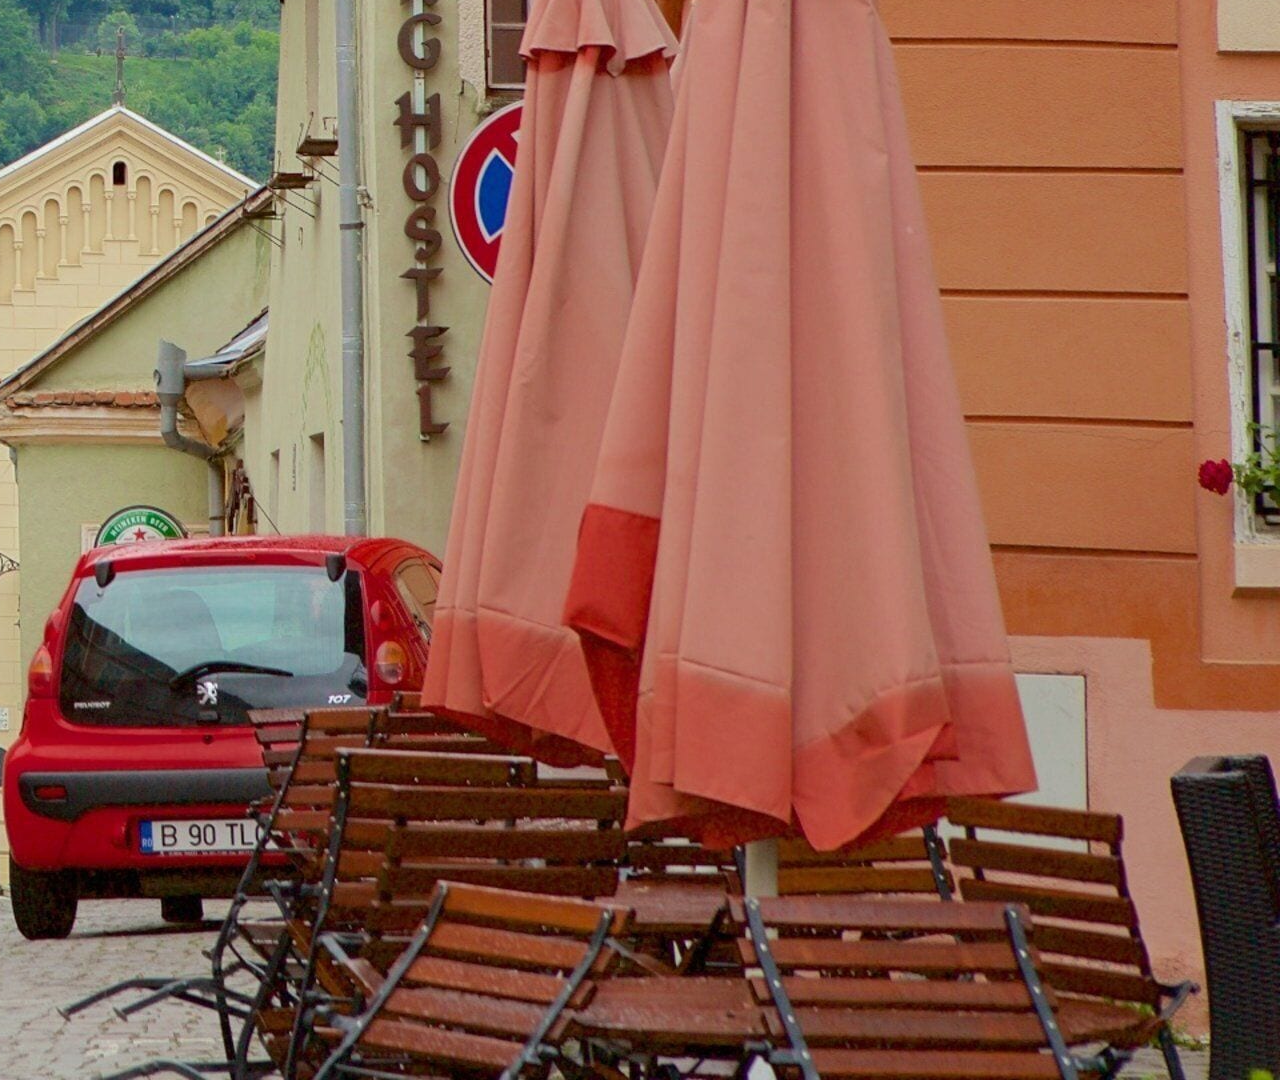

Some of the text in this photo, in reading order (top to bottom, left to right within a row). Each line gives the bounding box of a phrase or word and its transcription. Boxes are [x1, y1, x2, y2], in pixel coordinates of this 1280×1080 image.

[393, 90, 451, 437] HOSTEL
[327, 694, 352, 704] 107
[142, 838, 153, 848] RO
[160, 824, 177, 848] B
[188, 823, 216, 847] 90
